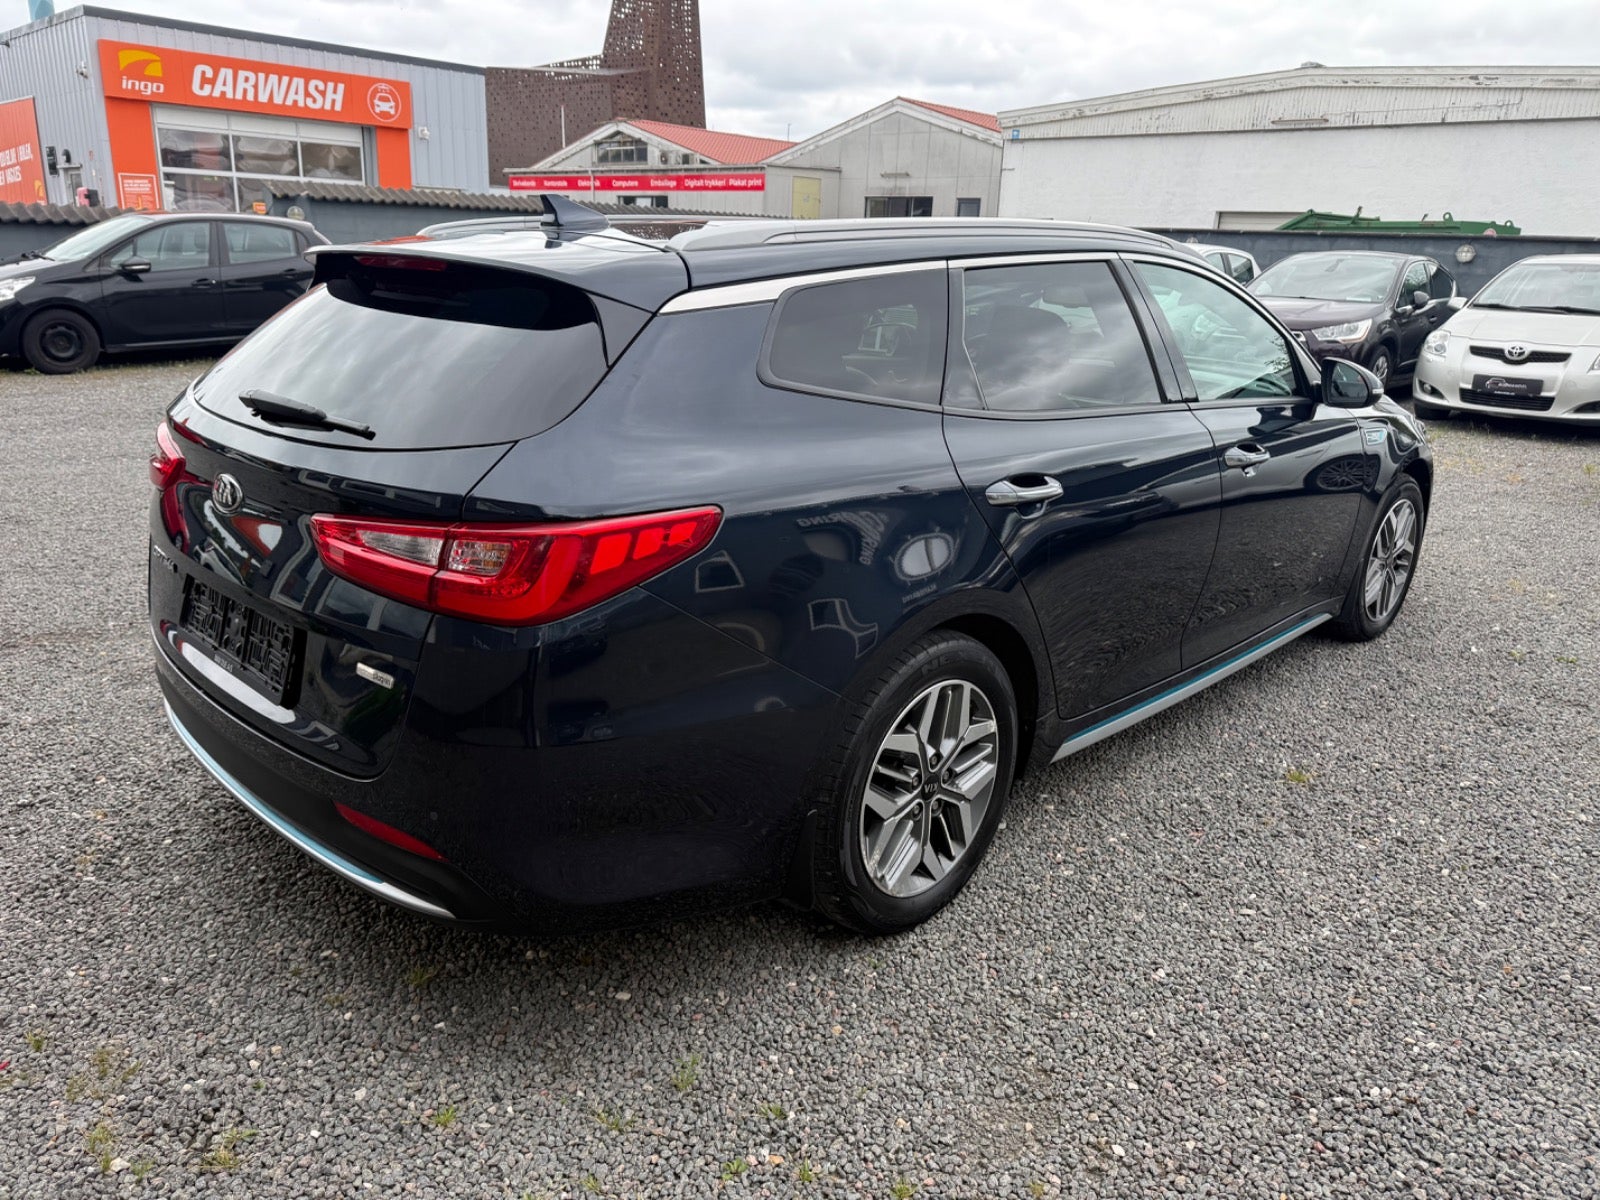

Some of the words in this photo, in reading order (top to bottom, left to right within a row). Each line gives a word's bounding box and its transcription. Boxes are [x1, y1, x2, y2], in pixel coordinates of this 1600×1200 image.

[121, 76, 165, 96] ingo
[191, 64, 345, 112] CARWASH
[728, 177, 747, 187] Plakat
[747, 177, 763, 188] print
